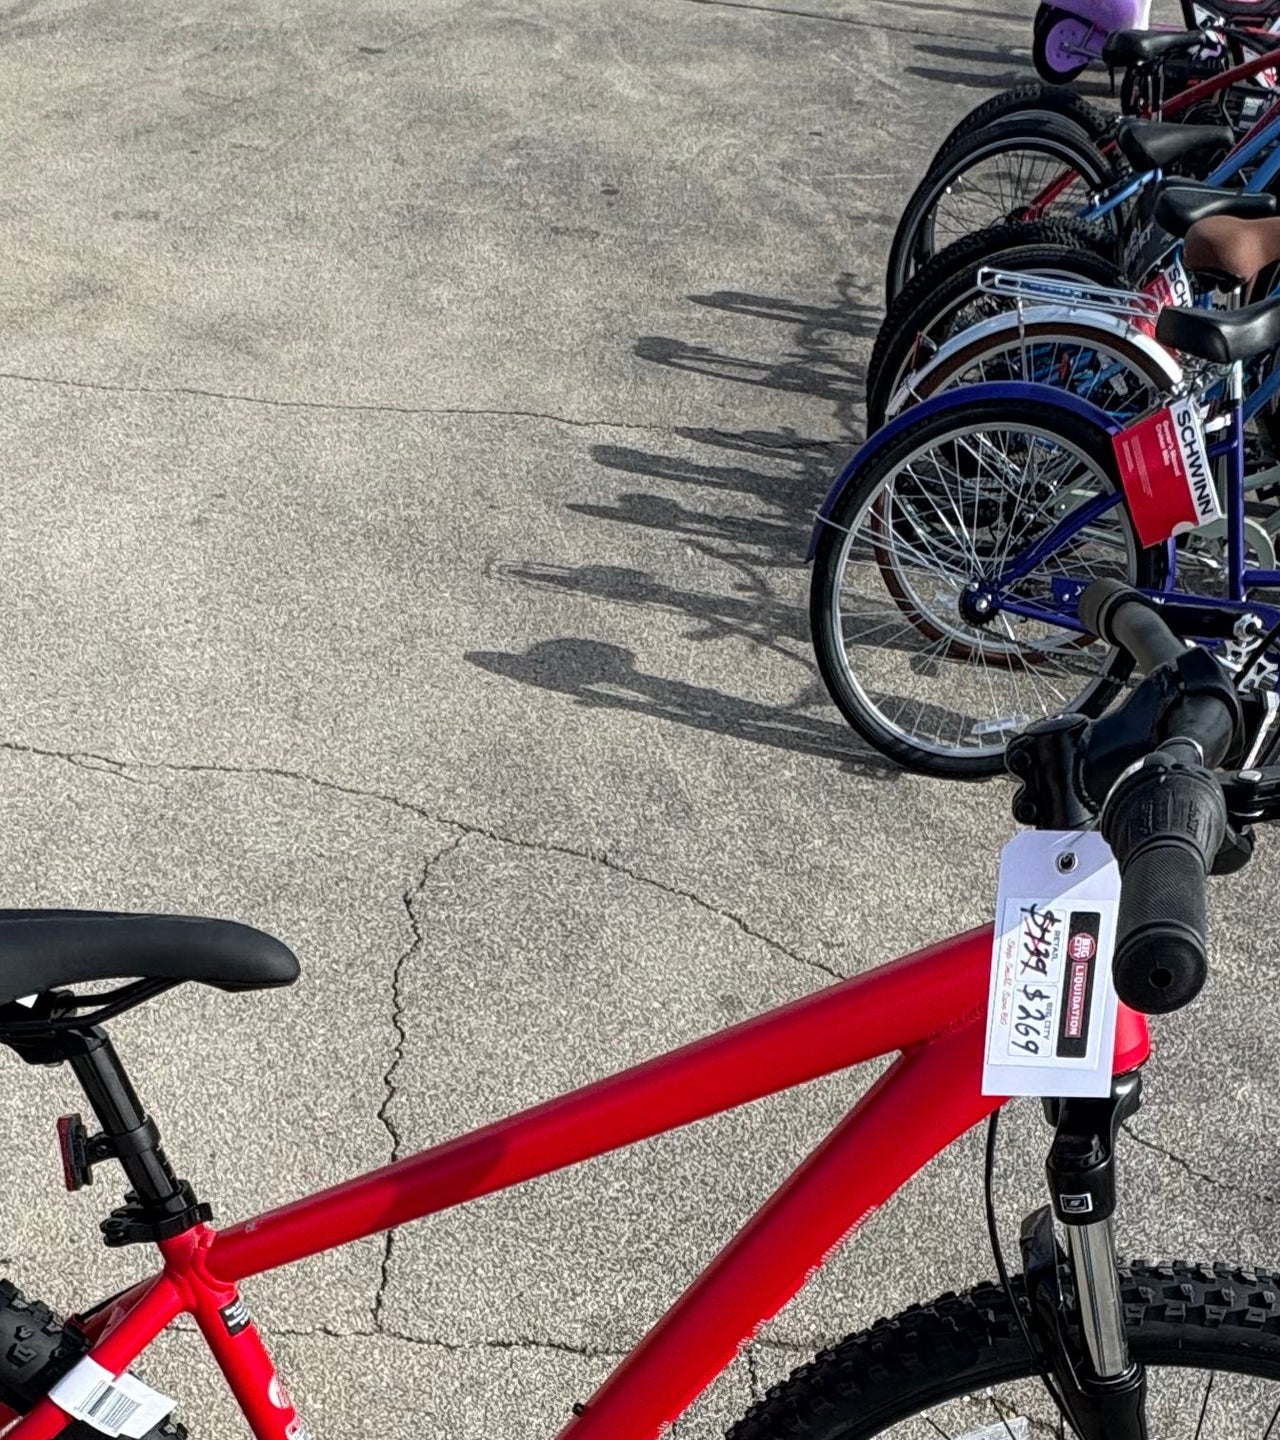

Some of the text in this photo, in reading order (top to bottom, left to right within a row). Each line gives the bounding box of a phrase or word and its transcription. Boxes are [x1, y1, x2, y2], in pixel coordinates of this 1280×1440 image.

[1177, 410, 1214, 516] SCHWINN
[1051, 930, 1062, 962] RETAIL
[1073, 936, 1082, 959] CITY
[1080, 937, 1092, 958] BIG
[1070, 965, 1085, 1036] LIQUIDATION
